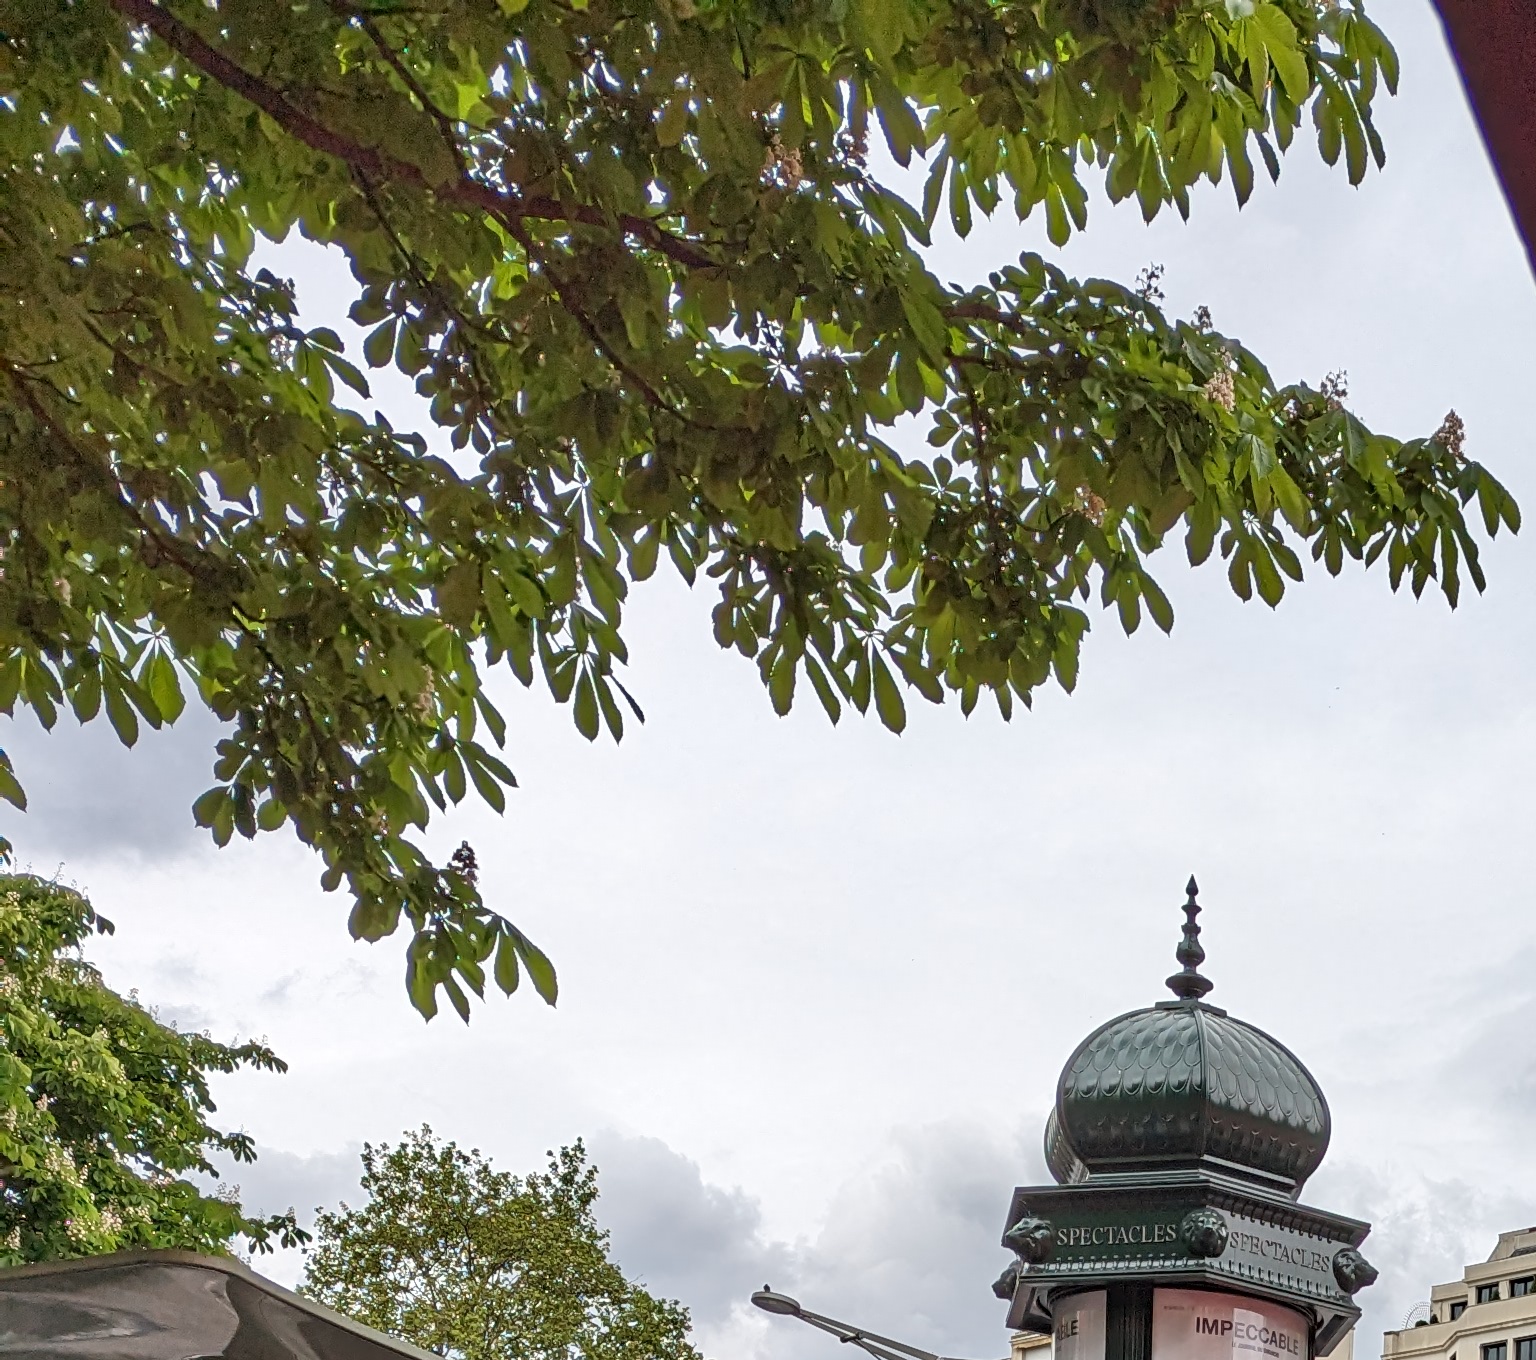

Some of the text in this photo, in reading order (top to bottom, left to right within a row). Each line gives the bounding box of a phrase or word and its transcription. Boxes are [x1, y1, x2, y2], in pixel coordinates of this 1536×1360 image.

[1057, 1224, 1177, 1246] SPECTACLES
[1229, 1231, 1330, 1272] SPECTACLES
[1196, 1316, 1299, 1356] IMPECCABLE
